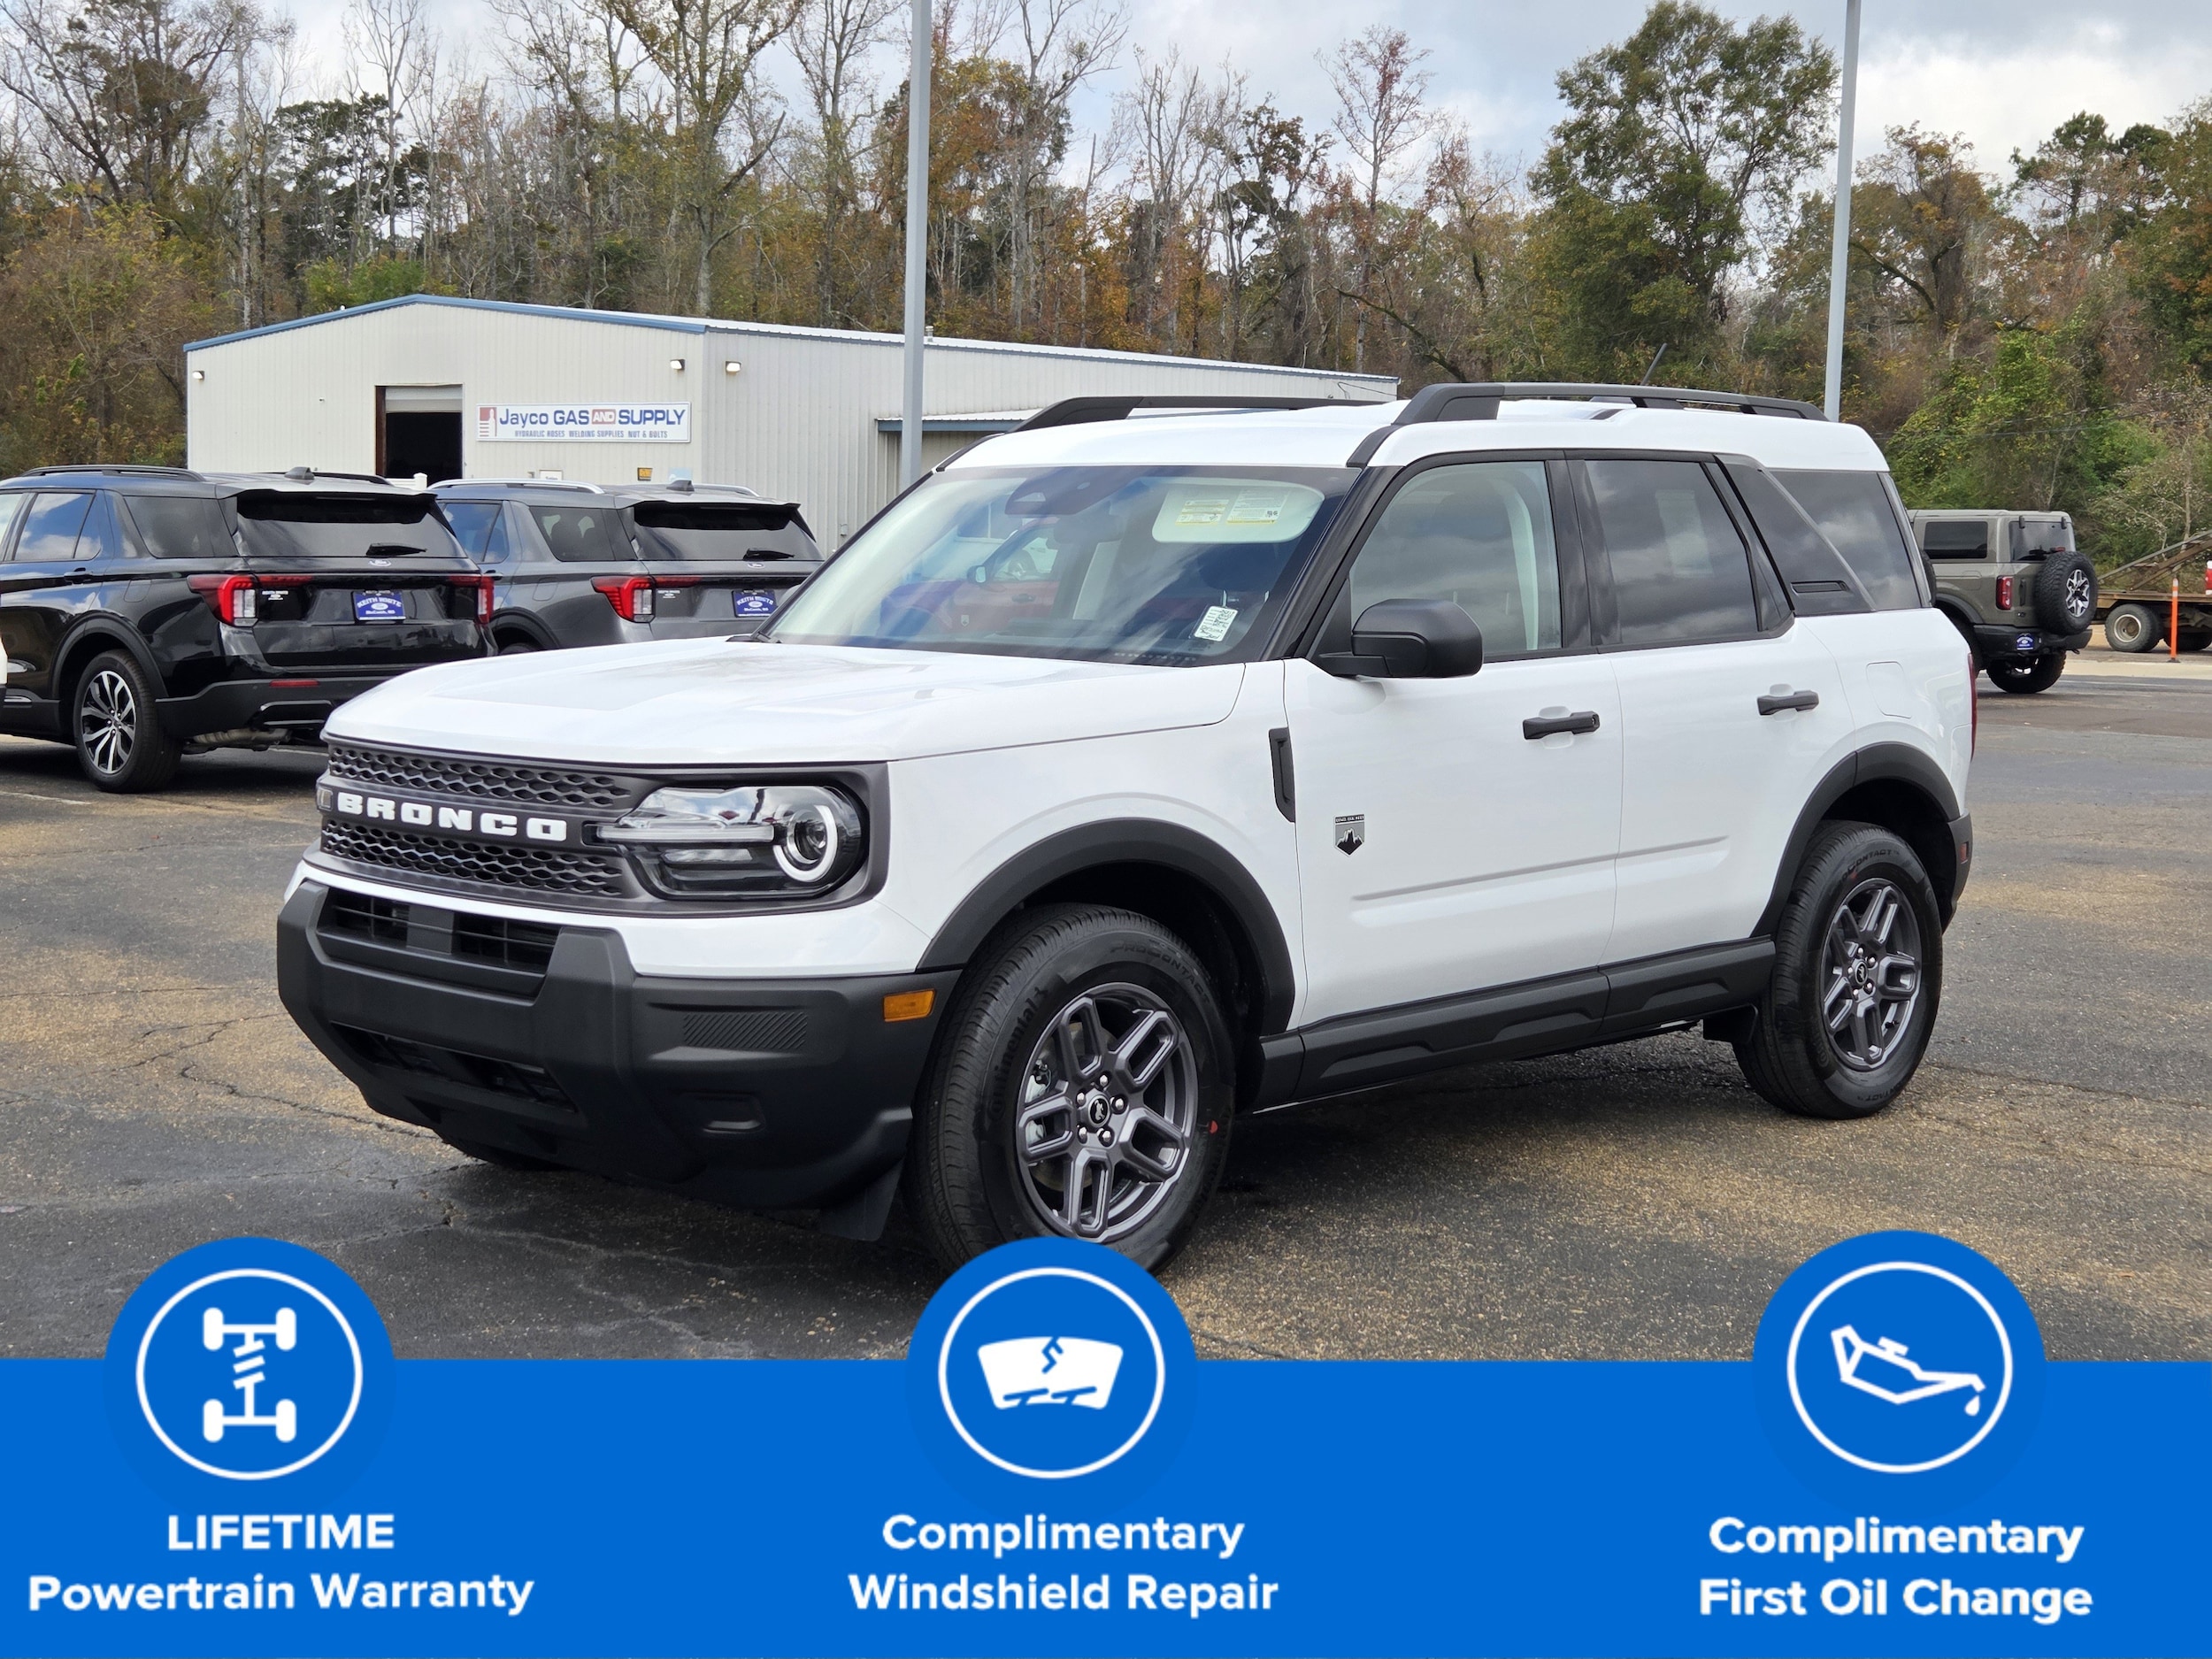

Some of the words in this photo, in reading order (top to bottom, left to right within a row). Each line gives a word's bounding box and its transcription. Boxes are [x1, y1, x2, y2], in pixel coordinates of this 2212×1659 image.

[499, 408, 549, 428] Jayco
[553, 410, 590, 426] GAS
[592, 411, 616, 423] AND
[618, 409, 686, 426] SUPPLY
[337, 791, 567, 841] BRONCO
